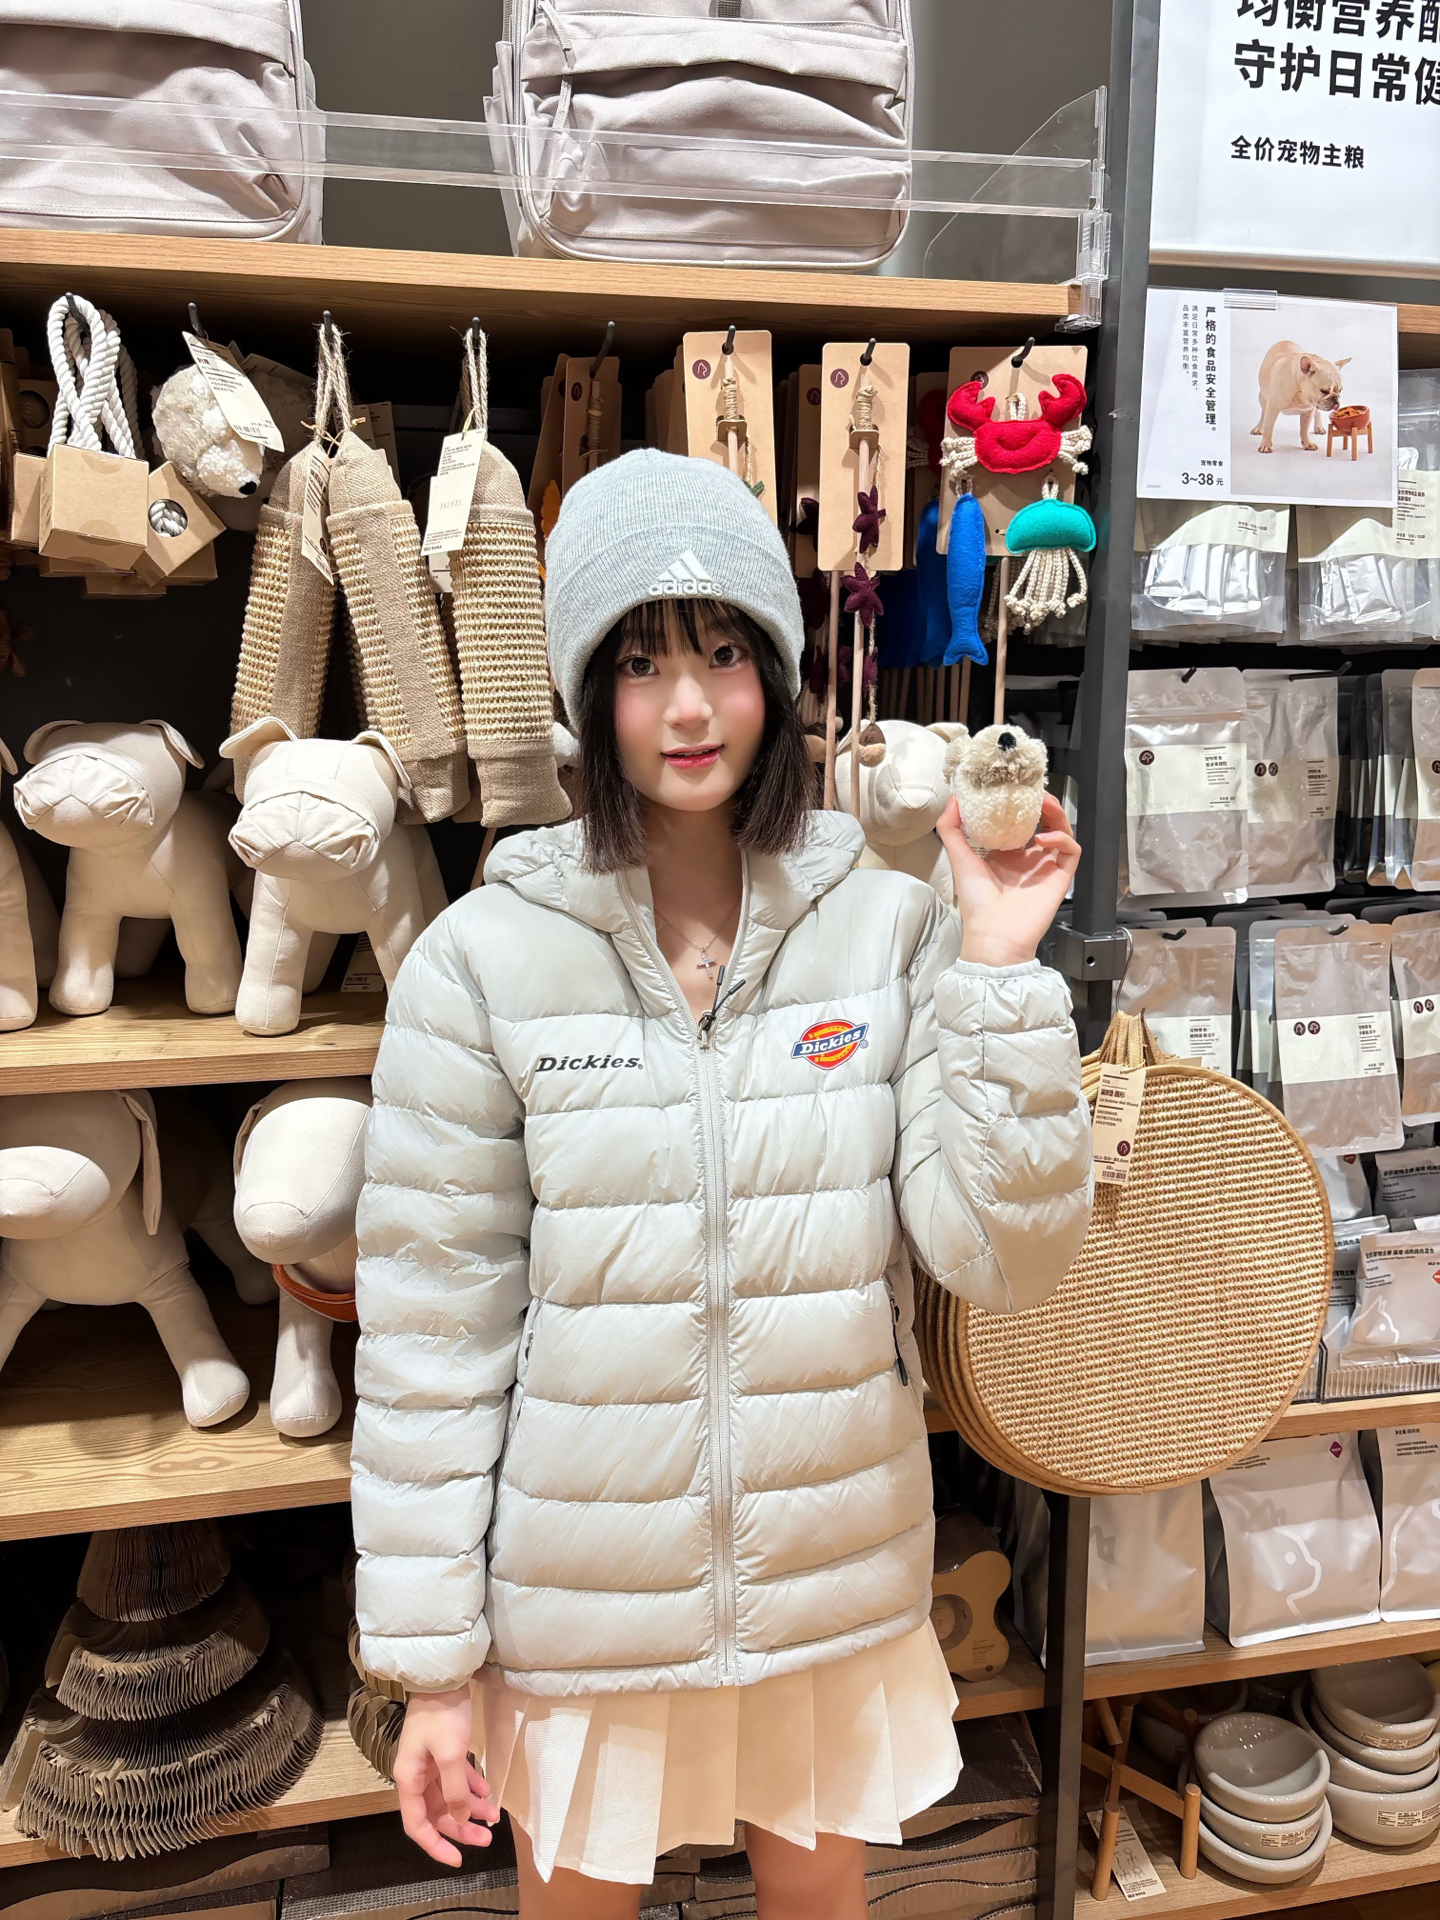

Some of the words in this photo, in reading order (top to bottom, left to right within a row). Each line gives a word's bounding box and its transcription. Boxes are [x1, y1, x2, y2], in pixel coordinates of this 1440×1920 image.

[1233, 38, 1440, 106] 守护日常健
[1231, 135, 1364, 169] 全价宠物主粮
[1205, 306, 1217, 432] 严格的食品安全管理。
[1200, 459, 1224, 467] 宠物零食
[648, 579, 723, 597] adidas
[800, 1029, 862, 1055] Dickies
